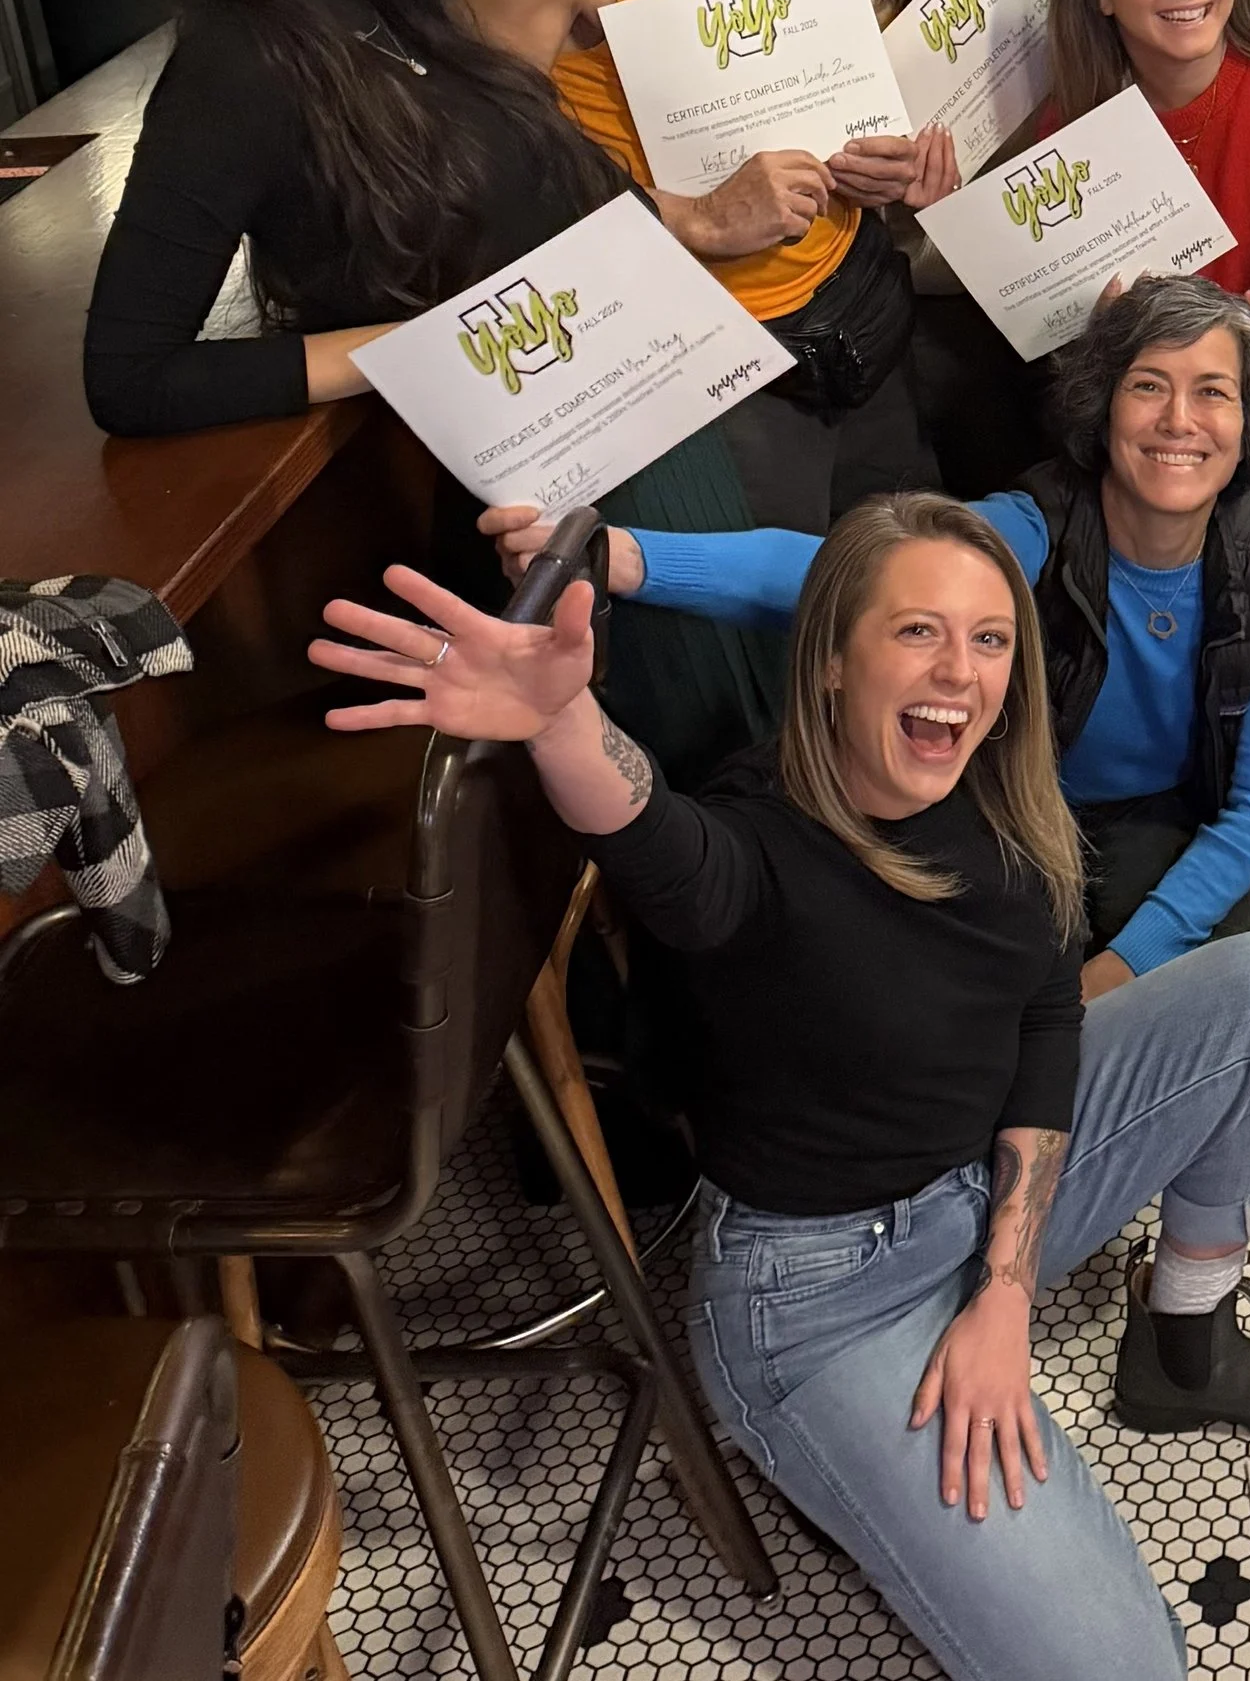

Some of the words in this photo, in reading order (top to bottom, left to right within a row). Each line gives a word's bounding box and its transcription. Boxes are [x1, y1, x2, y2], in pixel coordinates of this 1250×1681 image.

[782, 25, 800, 35] FALL
[800, 19, 818, 31] 2025
[667, 98, 728, 124] CERTIFICATE
[730, 93, 741, 105] OF
[744, 76, 800, 101] COMPLETION
[930, 87, 966, 124] ERTIFICATE
[963, 76, 973, 90] OF
[972, 38, 1011, 80] COMPLETION
[1002, 158, 1089, 243] YoYo
[1087, 183, 1105, 196] FALL
[1103, 172, 1122, 186] 2025
[999, 266, 1050, 297] CERTIFICATE
[1049, 259, 1059, 272] OF
[1061, 230, 1113, 265] COMPLETION
[459, 291, 578, 394] YoYo
[474, 423, 541, 466] CERTIFICATE
[538, 412, 553, 429] OF
[554, 368, 624, 417] COMPLETION
